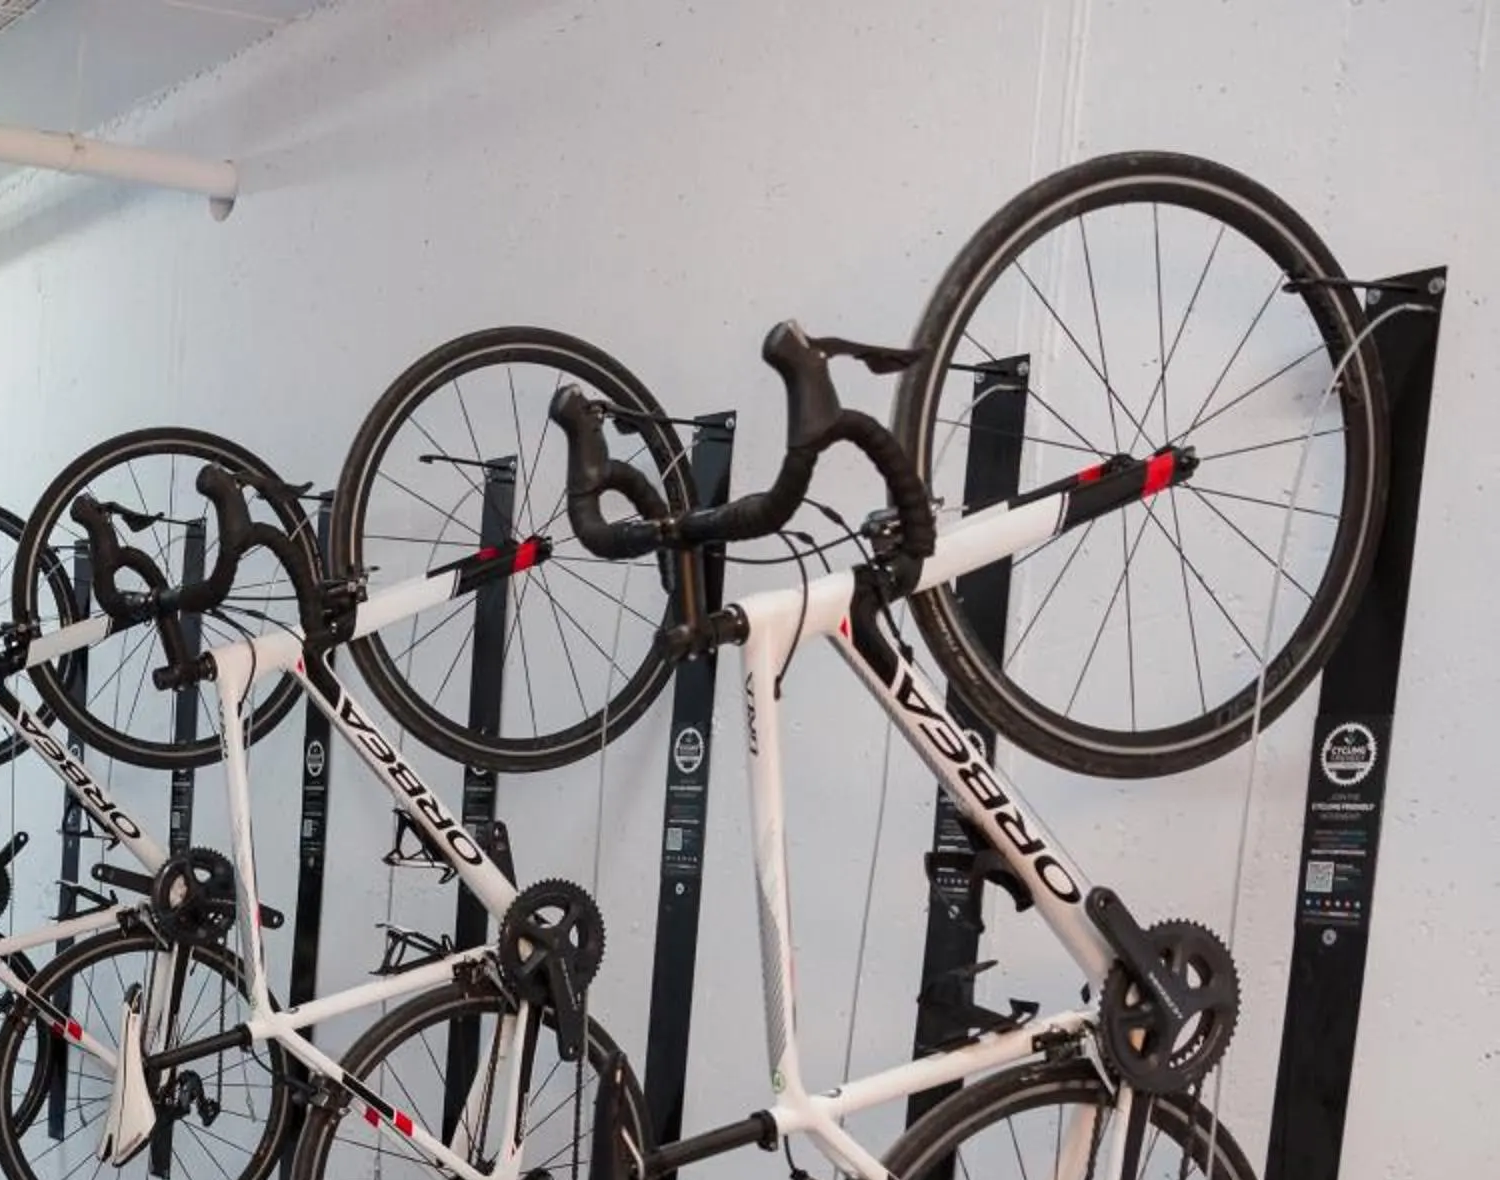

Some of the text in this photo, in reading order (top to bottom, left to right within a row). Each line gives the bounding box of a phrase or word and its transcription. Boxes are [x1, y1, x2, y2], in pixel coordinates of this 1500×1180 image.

[20, 710, 140, 838] ORBEA
[341, 697, 483, 865] ORBEA
[896, 671, 1081, 904] ORBEA
